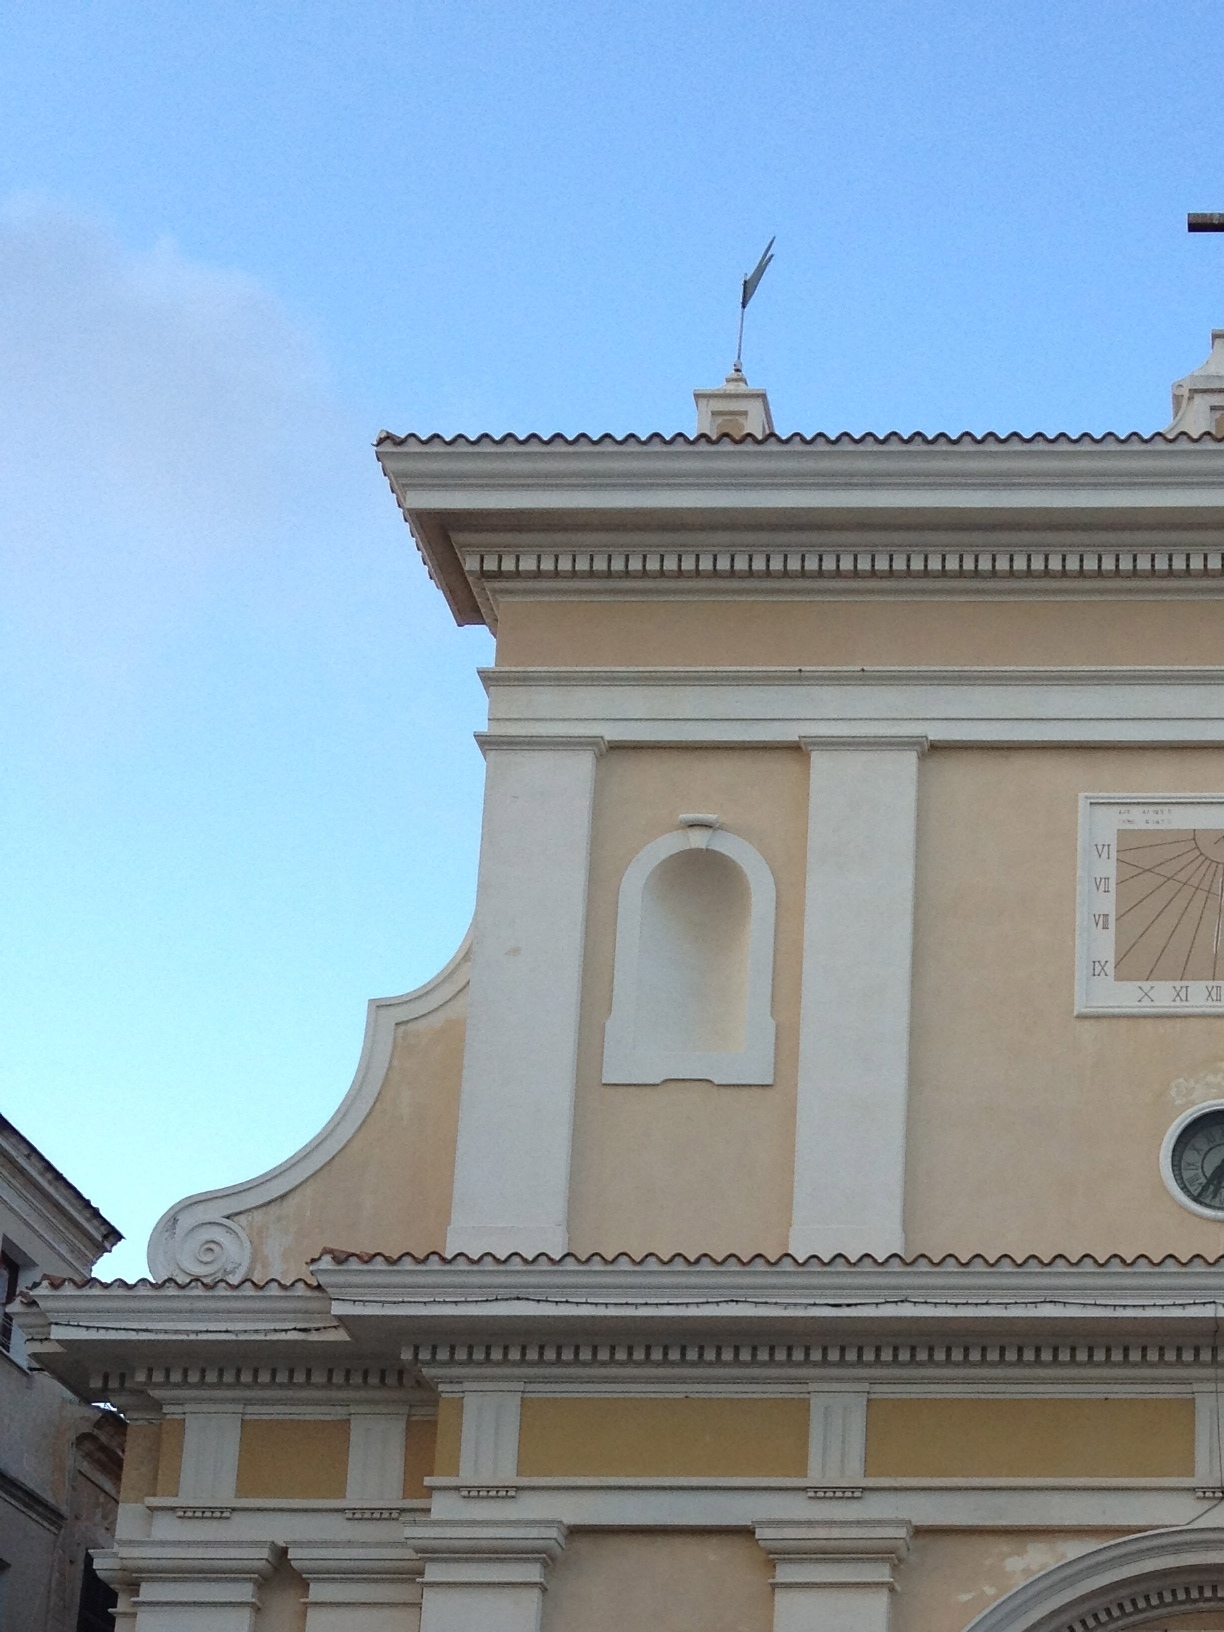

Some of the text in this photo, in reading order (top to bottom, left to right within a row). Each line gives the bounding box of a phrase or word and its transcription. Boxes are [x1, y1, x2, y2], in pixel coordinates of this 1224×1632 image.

[1095, 844, 1110, 859] VI
[1095, 877, 1110, 893] VII
[1093, 914, 1109, 929] VIII
[1092, 961, 1108, 976] IX
[1138, 986, 1154, 1002] X
[1172, 986, 1189, 1002] XI
[1206, 986, 1221, 1001] XII
